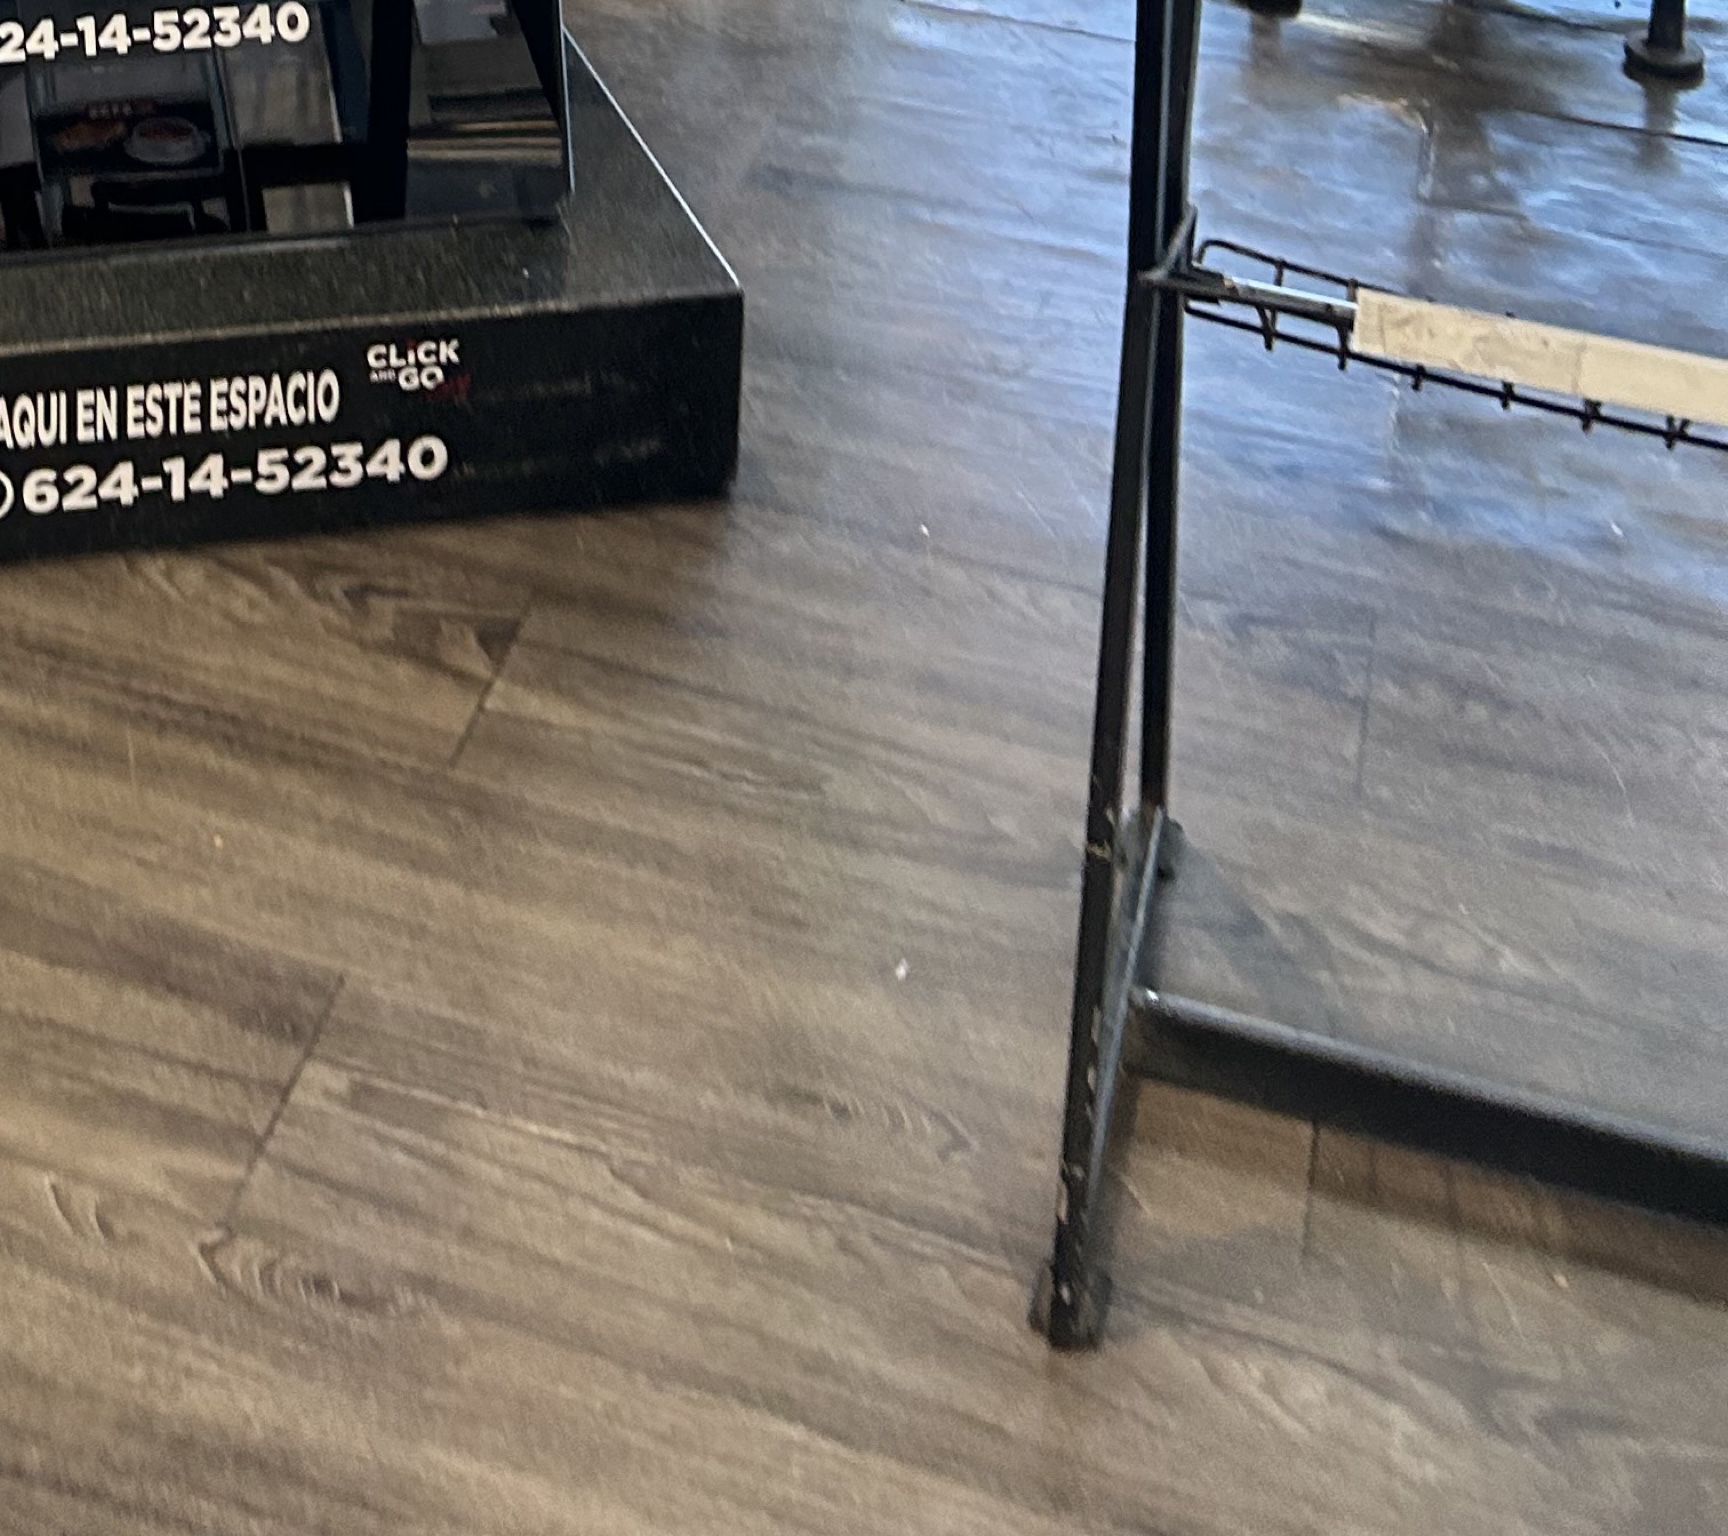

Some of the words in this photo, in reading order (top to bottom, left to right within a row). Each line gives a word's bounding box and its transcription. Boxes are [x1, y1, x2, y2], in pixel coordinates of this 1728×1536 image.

[77, 387, 116, 445] EN
[125, 380, 202, 439] ESTE
[209, 371, 340, 429] ESPACIO
[398, 365, 445, 392] GO
[21, 435, 448, 517] 624-14-52340
